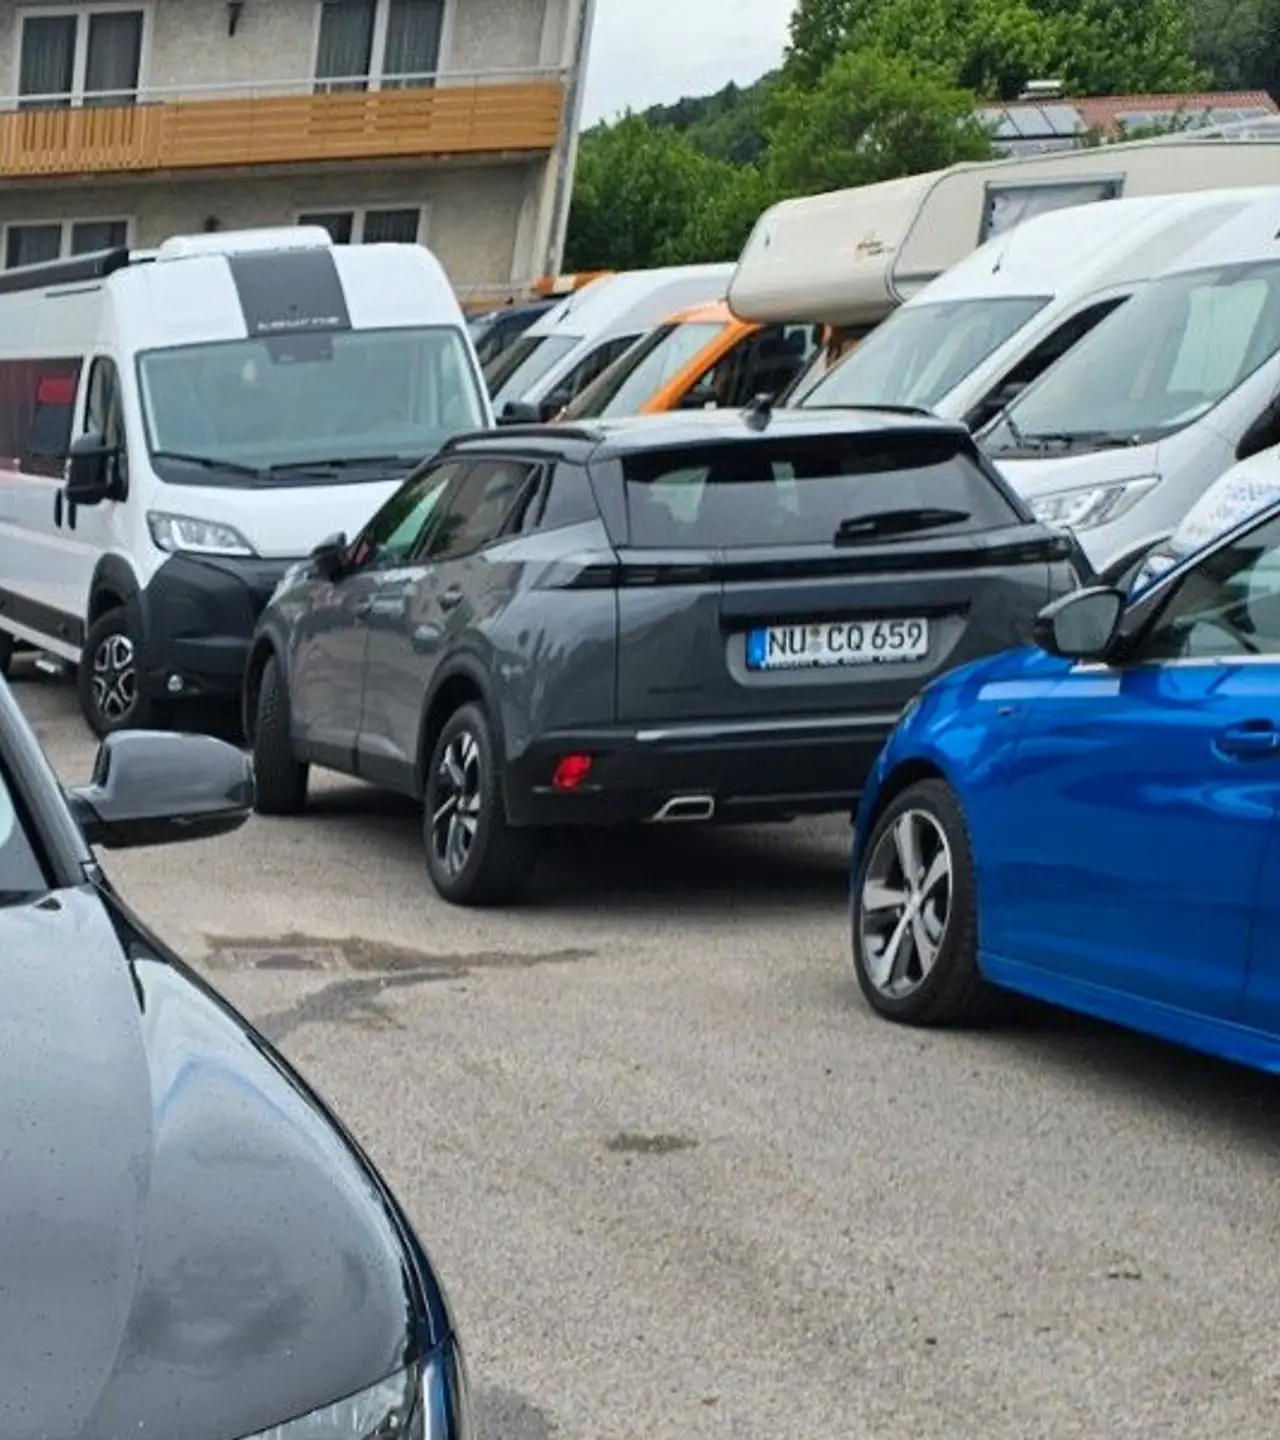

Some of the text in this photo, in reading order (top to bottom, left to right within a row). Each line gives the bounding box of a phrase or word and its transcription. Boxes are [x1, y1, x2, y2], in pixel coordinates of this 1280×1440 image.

[768, 621, 923, 656] NU CQ 659
